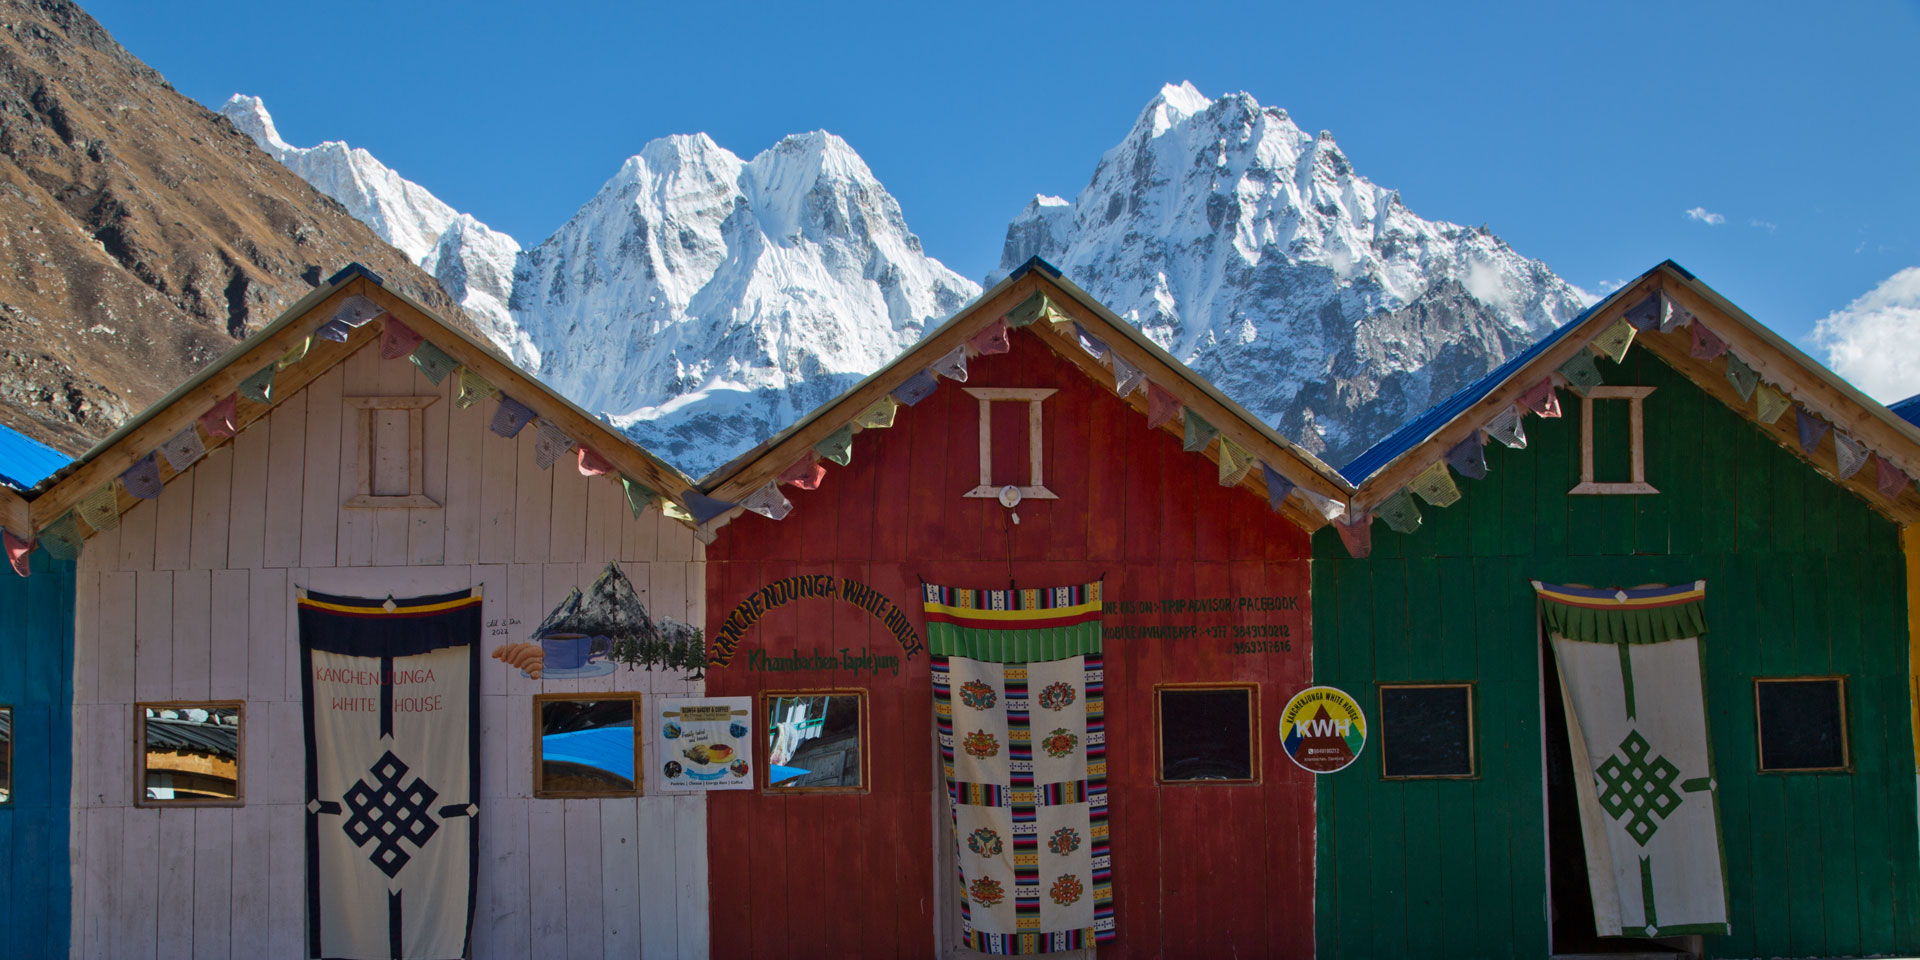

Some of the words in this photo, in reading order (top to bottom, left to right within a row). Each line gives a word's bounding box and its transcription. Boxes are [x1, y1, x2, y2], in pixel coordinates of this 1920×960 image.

[708, 574, 838, 668] KANCHENJUNGA
[841, 577, 890, 619] WHITE
[883, 605, 924, 661] HOUSE
[316, 666, 435, 686] KANCHENJUNGA
[332, 697, 376, 713] WHITE
[394, 695, 442, 713] HOUSE
[1286, 692, 1323, 724] KANCHENJUNGA
[1325, 692, 1345, 706] WHITE
[1342, 702, 1359, 721] HOUSE
[1295, 718, 1351, 738] KWH
